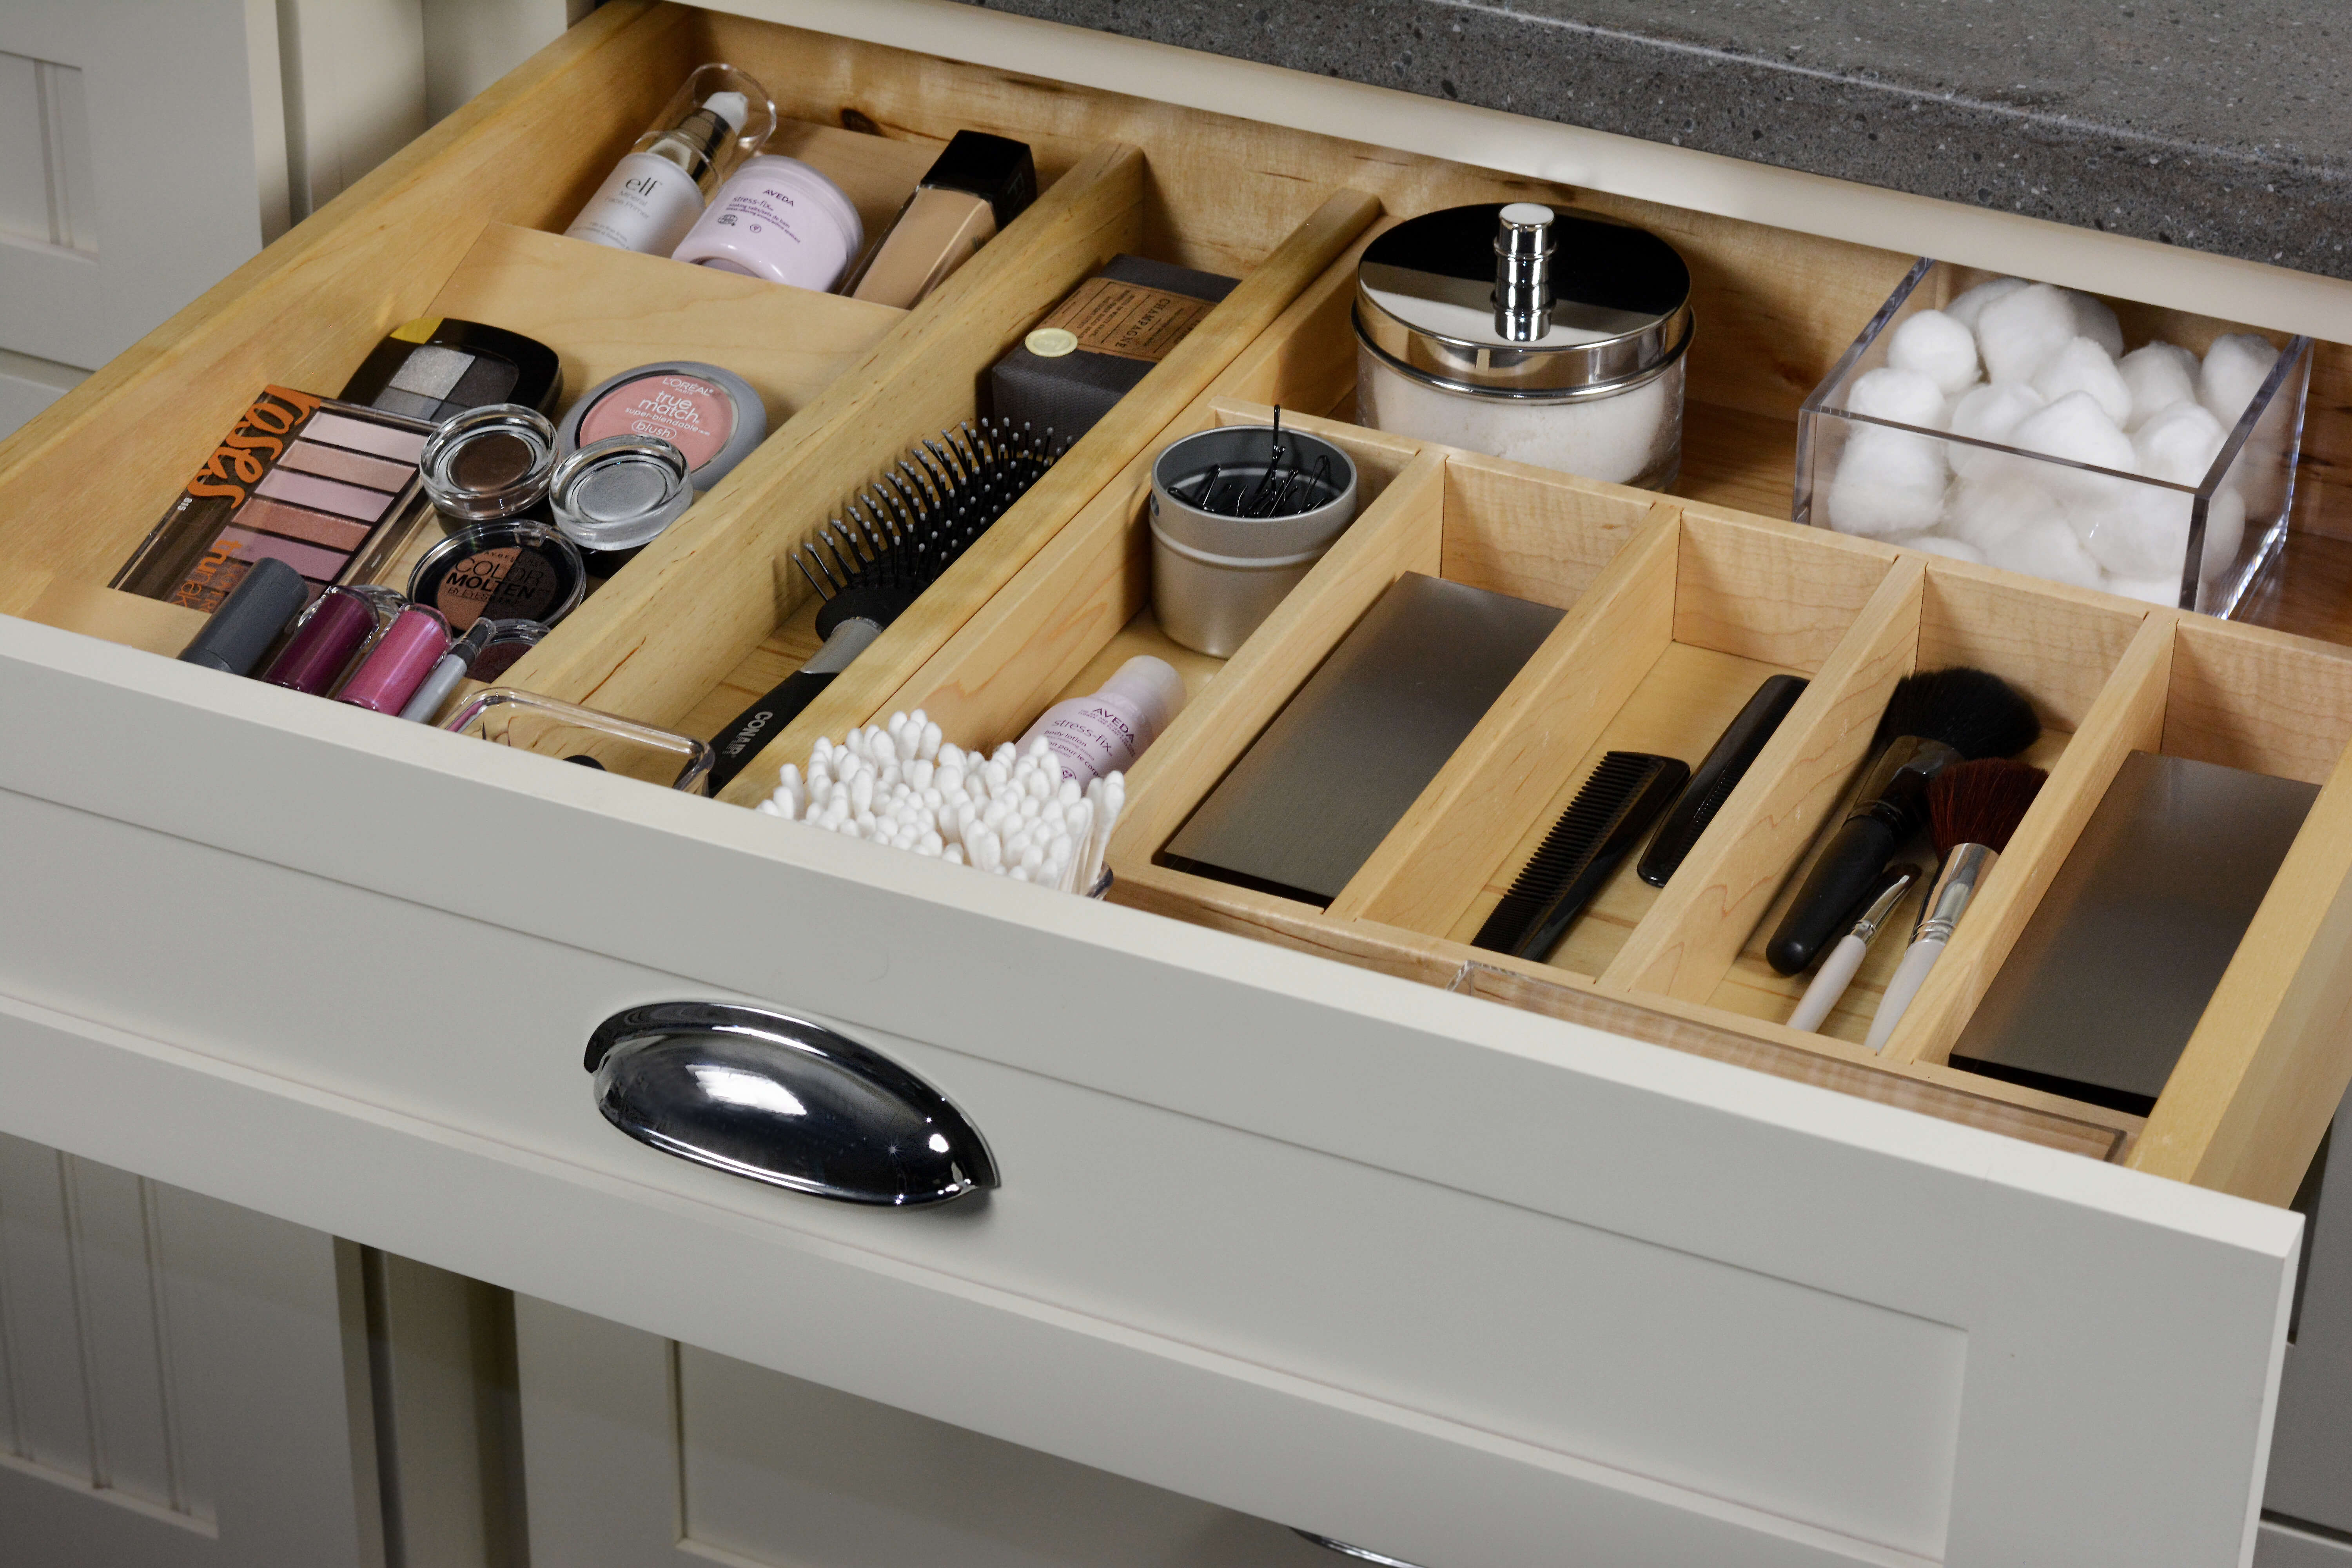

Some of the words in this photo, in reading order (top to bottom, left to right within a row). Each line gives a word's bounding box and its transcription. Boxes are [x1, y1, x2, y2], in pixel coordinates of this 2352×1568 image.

[626, 178, 662, 196] elf
[762, 189, 793, 207] AVEDA
[1115, 298, 1171, 349] CHAMPAGNE
[656, 391, 692, 409] true
[675, 387, 693, 396] PARIS
[639, 399, 699, 423] match
[636, 421, 671, 437] blush
[187, 384, 321, 509] roses
[455, 558, 544, 586] COLOR
[446, 572, 536, 599] MOLTEN
[722, 711, 773, 755] CONAIR
[1092, 708, 1134, 743] AVEDA
[1065, 733, 1087, 747] lotion
